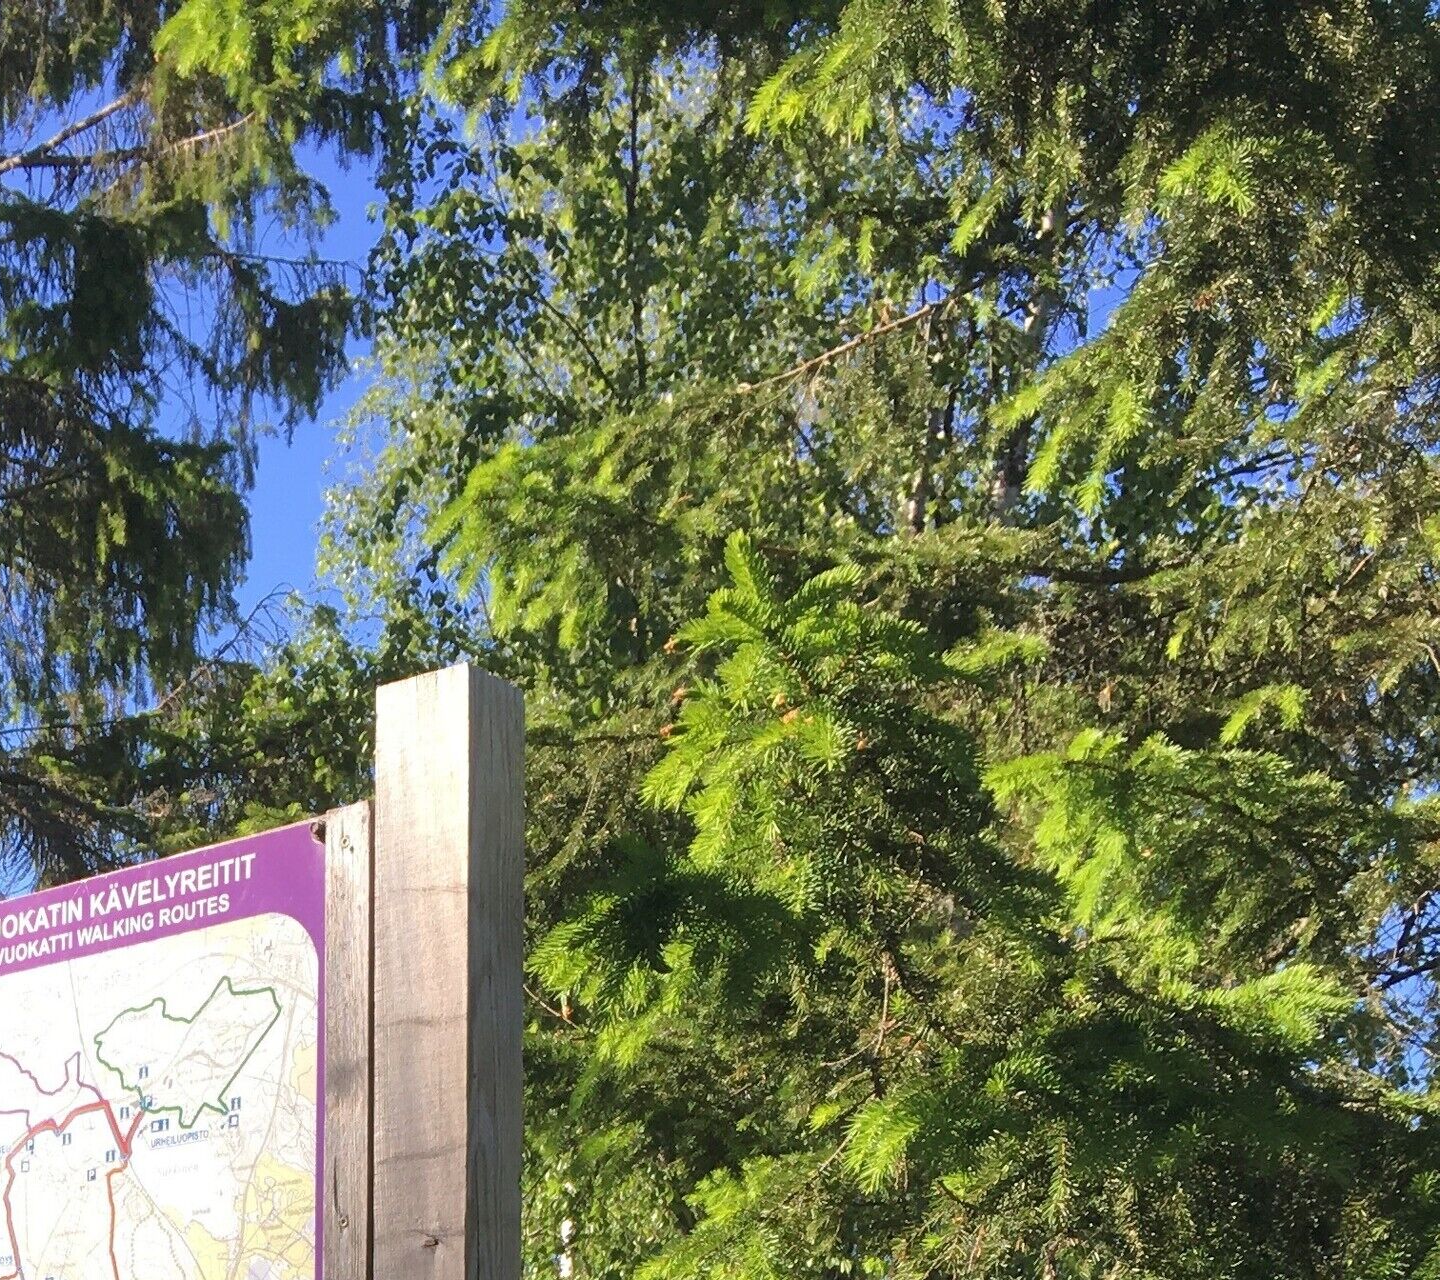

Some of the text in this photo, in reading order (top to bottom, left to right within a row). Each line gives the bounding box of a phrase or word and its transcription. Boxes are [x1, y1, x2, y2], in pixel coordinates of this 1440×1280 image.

[89, 853, 256, 918] KÄVELYREITIT
[77, 912, 155, 946] WALKING
[159, 893, 230, 928] ROUTES
